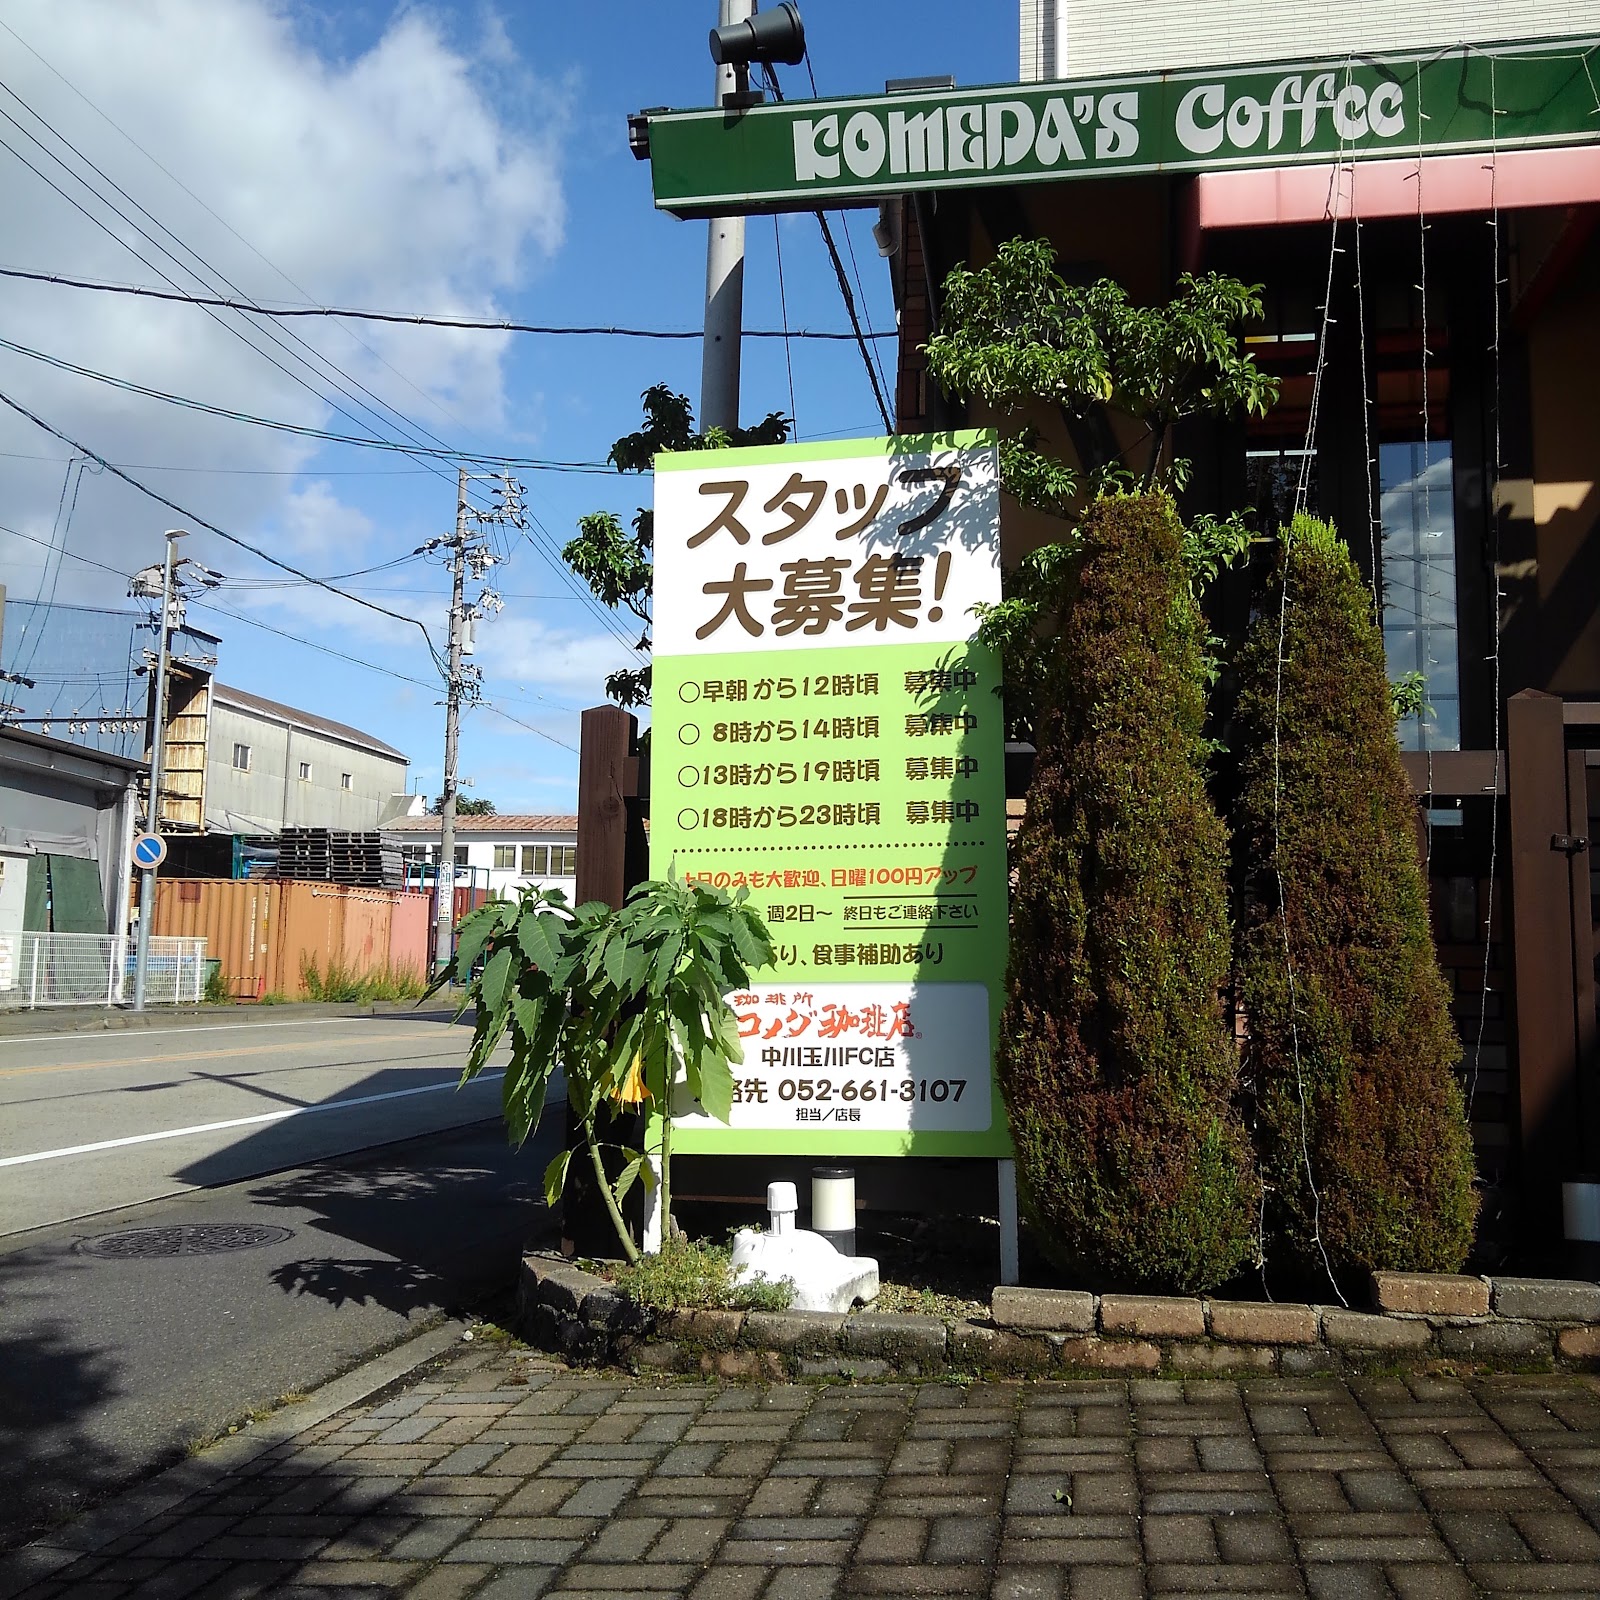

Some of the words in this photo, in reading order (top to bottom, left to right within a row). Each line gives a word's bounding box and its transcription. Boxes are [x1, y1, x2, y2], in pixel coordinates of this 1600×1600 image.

[792, 91, 1140, 182] KOMEDA'S
[1175, 73, 1405, 154] Coffee
[686, 467, 962, 550] スタッフ
[695, 551, 952, 640] 大募集！
[904, 669, 977, 694] 募集中
[904, 712, 978, 737] 募集中
[905, 755, 979, 781] 募集中
[906, 799, 980, 825] 募集中
[844, 904, 979, 921] 終日もご連絡下さい
[773, 943, 944, 966] り、食事補助あり
[762, 1046, 895, 1067] 中川玉川FC店
[778, 1079, 967, 1103] 052-661-3107
[795, 1107, 861, 1122] 担当／店長
